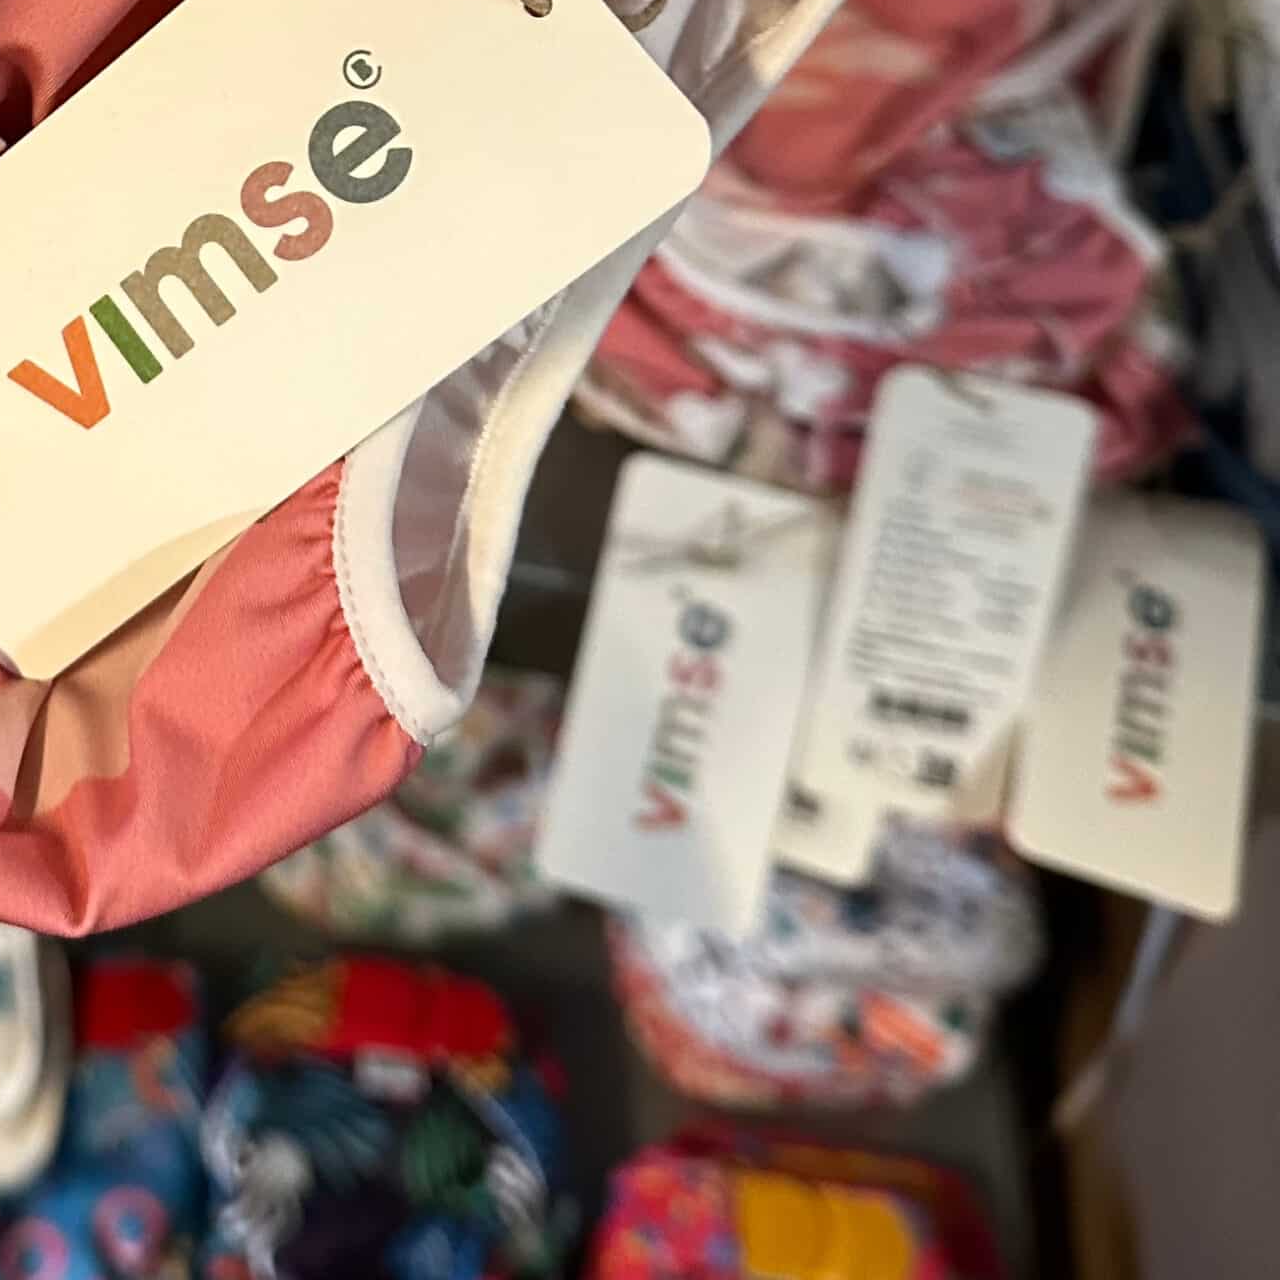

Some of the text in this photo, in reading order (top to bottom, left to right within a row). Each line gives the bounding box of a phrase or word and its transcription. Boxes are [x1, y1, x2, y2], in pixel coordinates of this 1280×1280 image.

[7, 100, 413, 431] vimse
[630, 600, 734, 833] vimse
[1104, 582, 1177, 806] vimse
